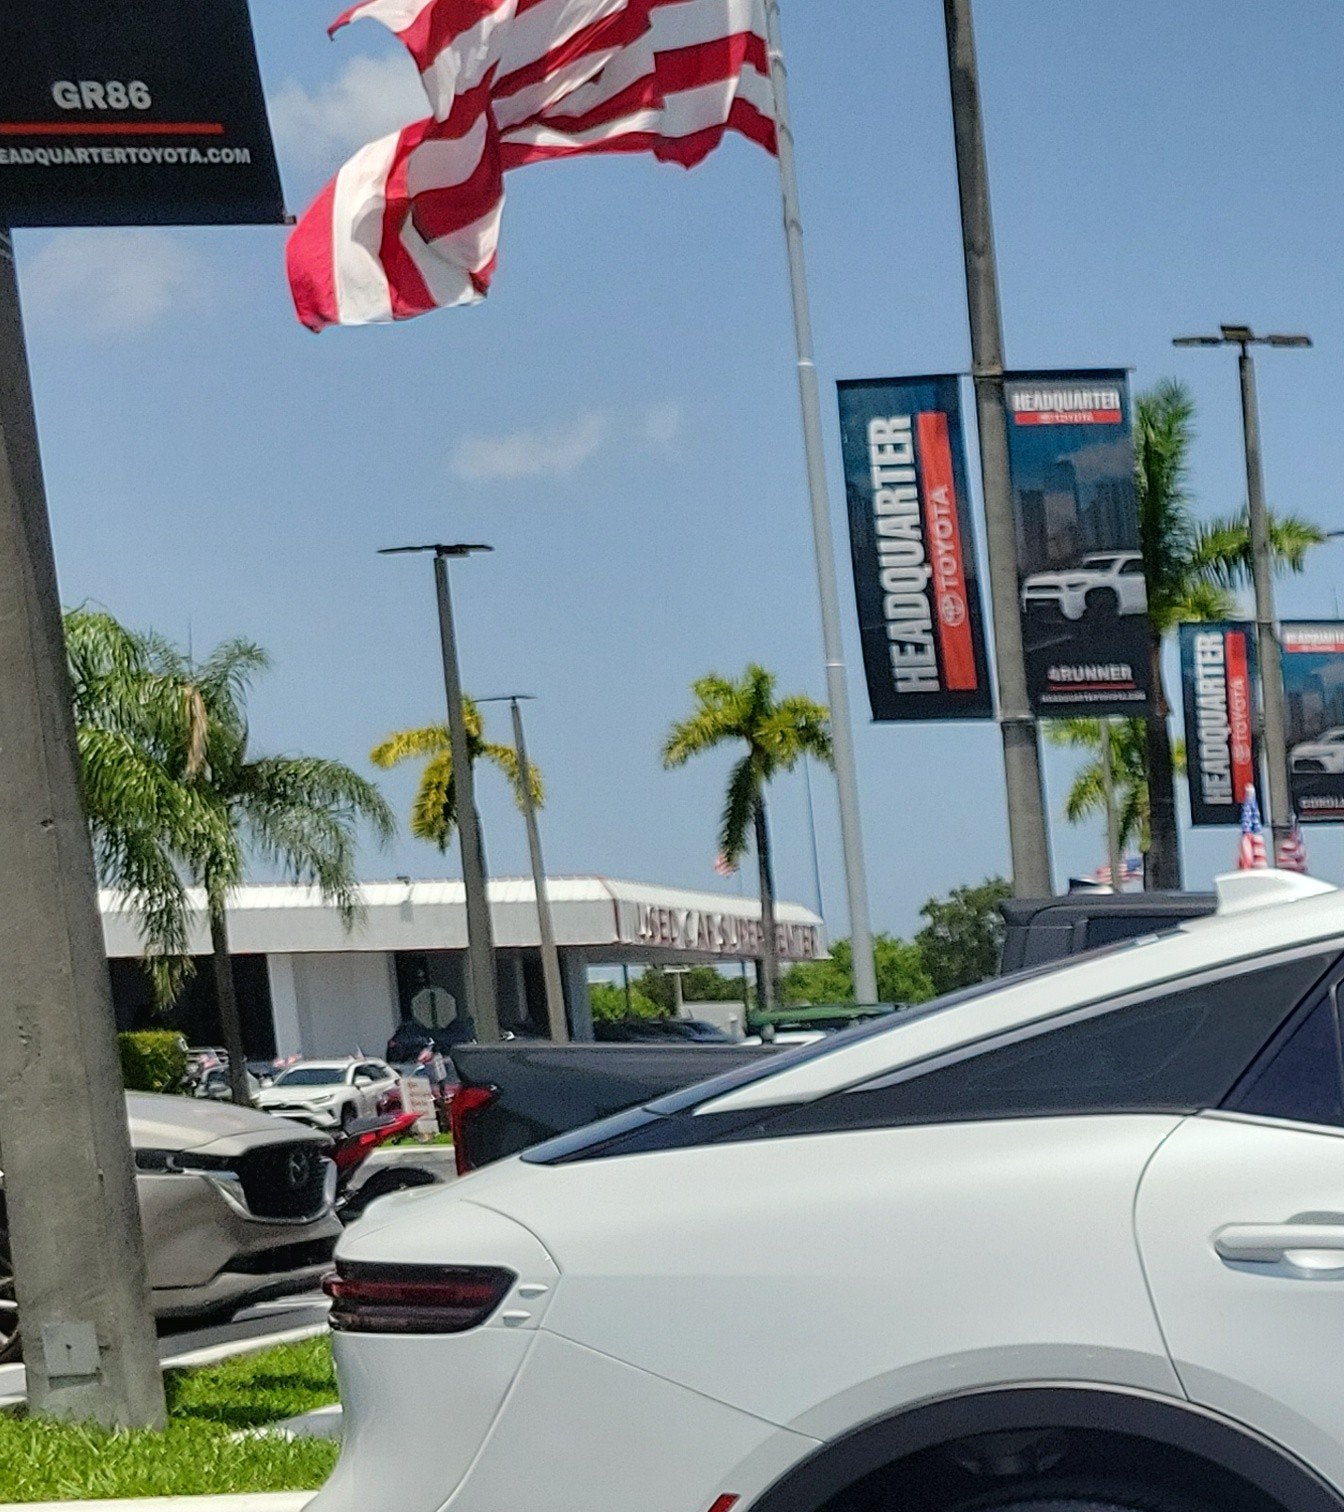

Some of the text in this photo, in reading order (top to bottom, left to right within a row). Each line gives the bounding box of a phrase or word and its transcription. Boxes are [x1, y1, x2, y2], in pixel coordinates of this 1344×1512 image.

[53, 80, 152, 110] GR86
[0, 147, 251, 166] EADQUARTERTOYOTA.COM
[868, 414, 940, 693] HEADQUARTER
[929, 483, 960, 588] TOYOTA
[1195, 631, 1233, 805] HEADQUARTER
[1231, 676, 1248, 742] TOYOTA
